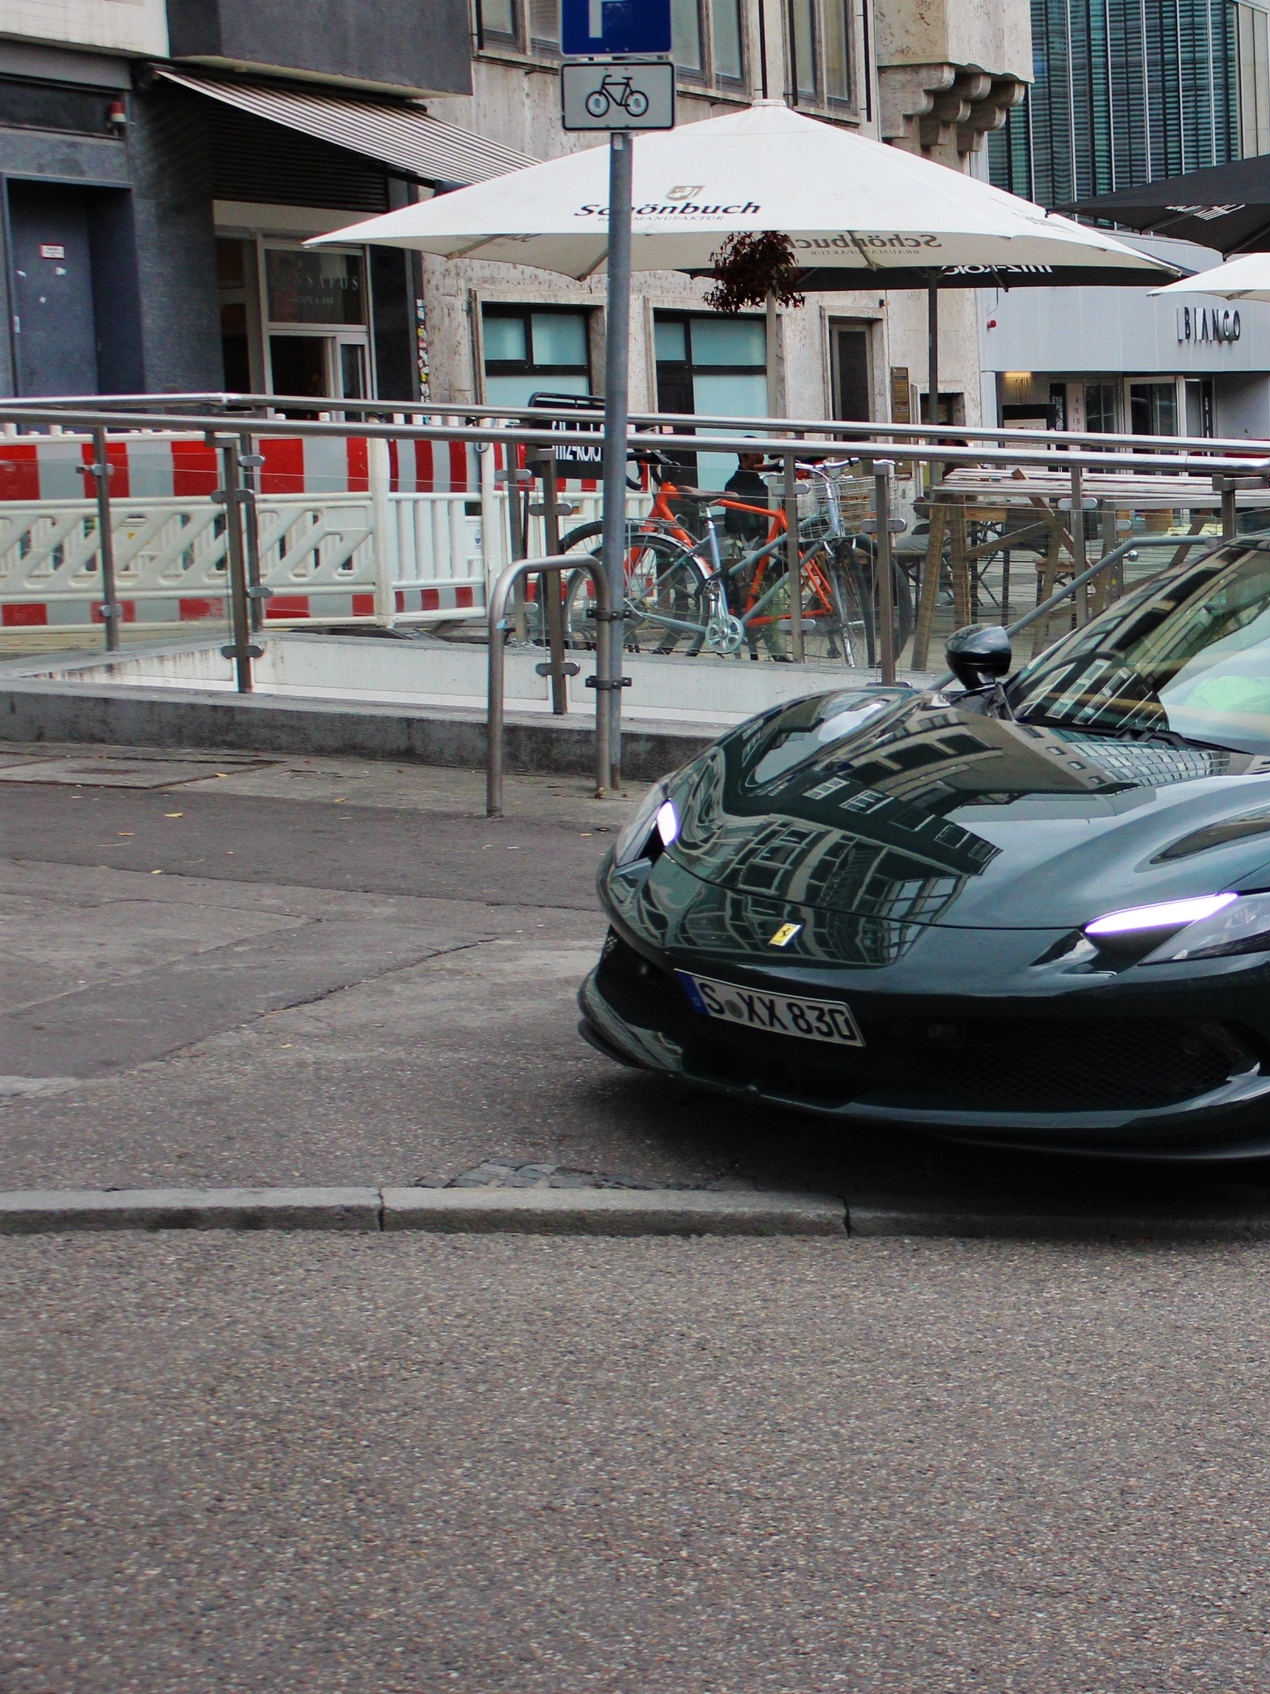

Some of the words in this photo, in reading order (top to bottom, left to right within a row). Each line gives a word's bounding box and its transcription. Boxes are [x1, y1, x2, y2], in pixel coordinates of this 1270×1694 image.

[574, 201, 761, 216] Scönbuch
[699, 982, 726, 1015] S
[736, 991, 790, 1031] XX
[786, 1001, 858, 1041] 830
